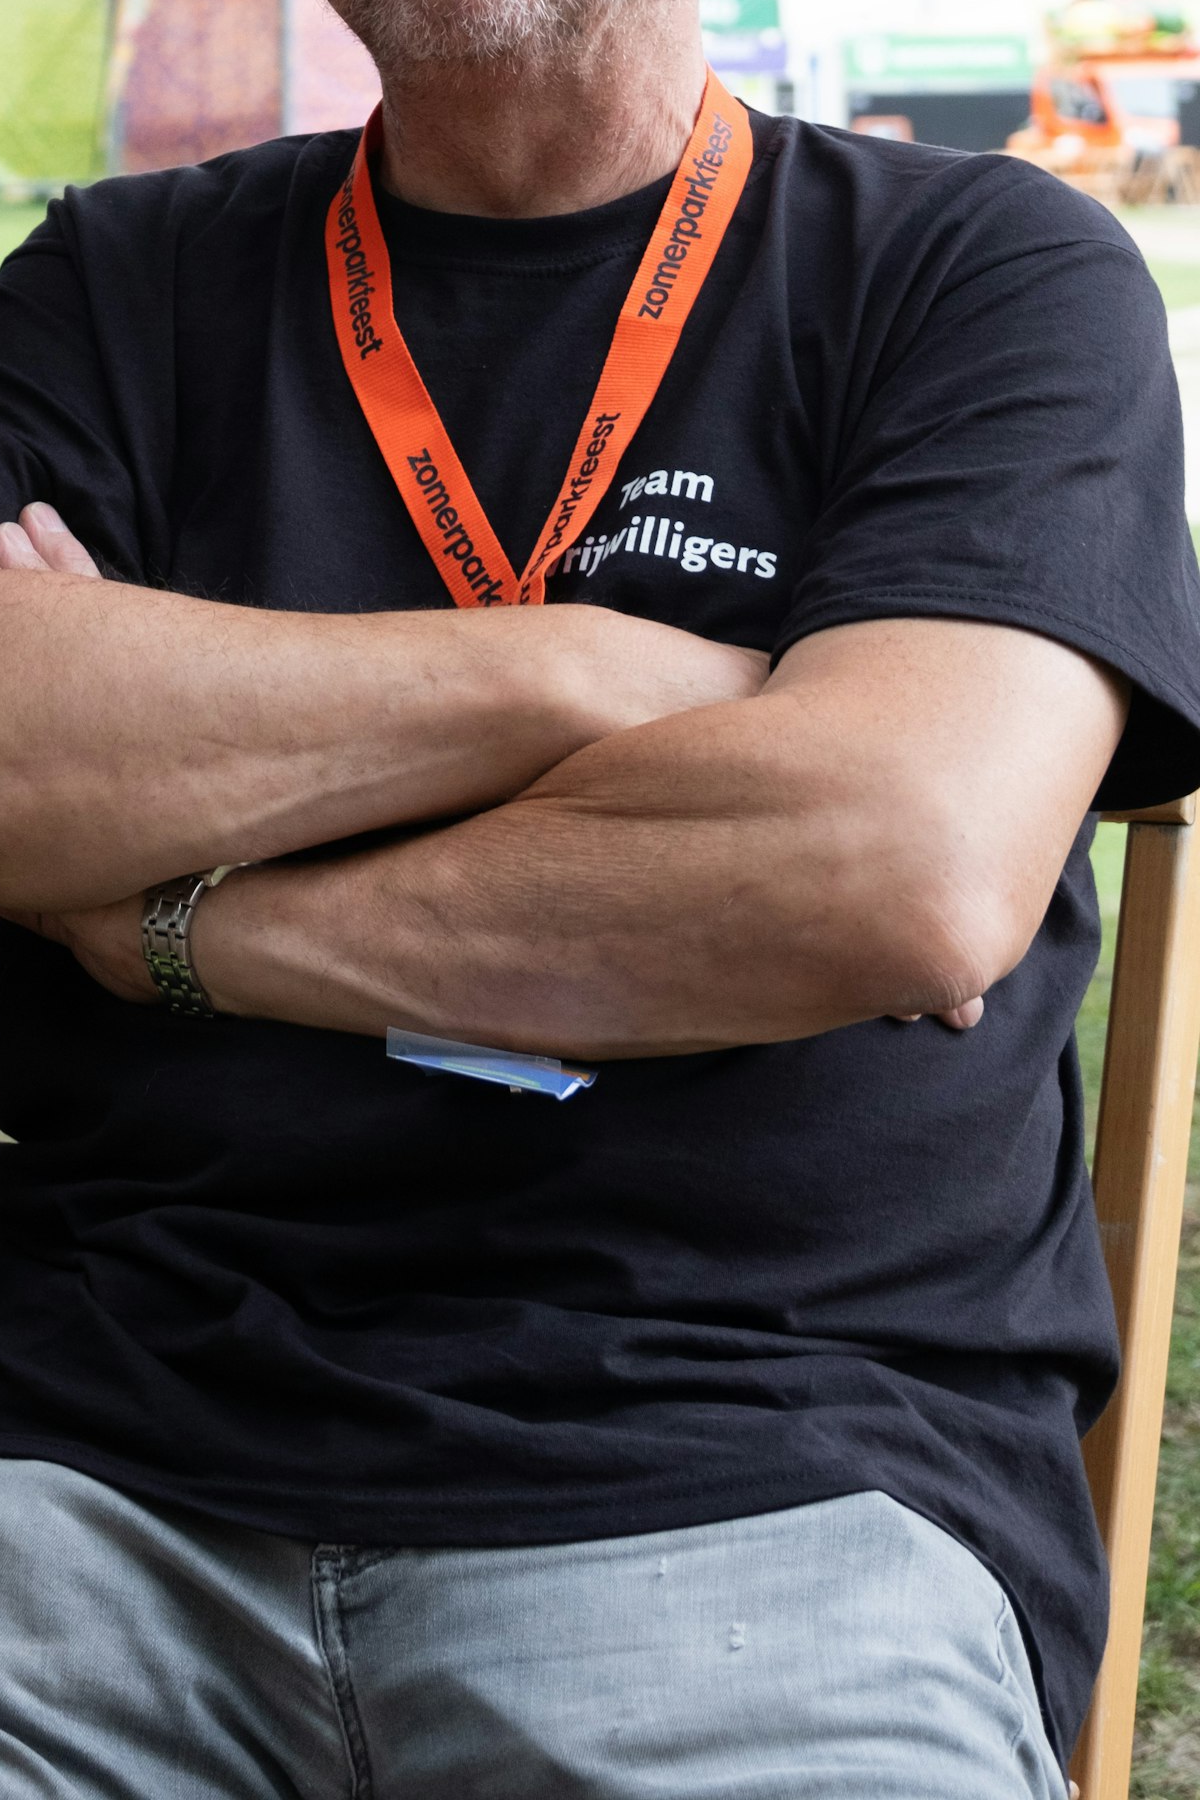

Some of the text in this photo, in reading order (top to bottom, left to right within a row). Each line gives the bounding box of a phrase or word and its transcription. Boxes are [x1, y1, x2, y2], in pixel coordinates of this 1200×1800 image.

[335, 172, 384, 361] merparkfeest
[637, 111, 734, 320] zomerparkfeest
[619, 469, 715, 511] Team
